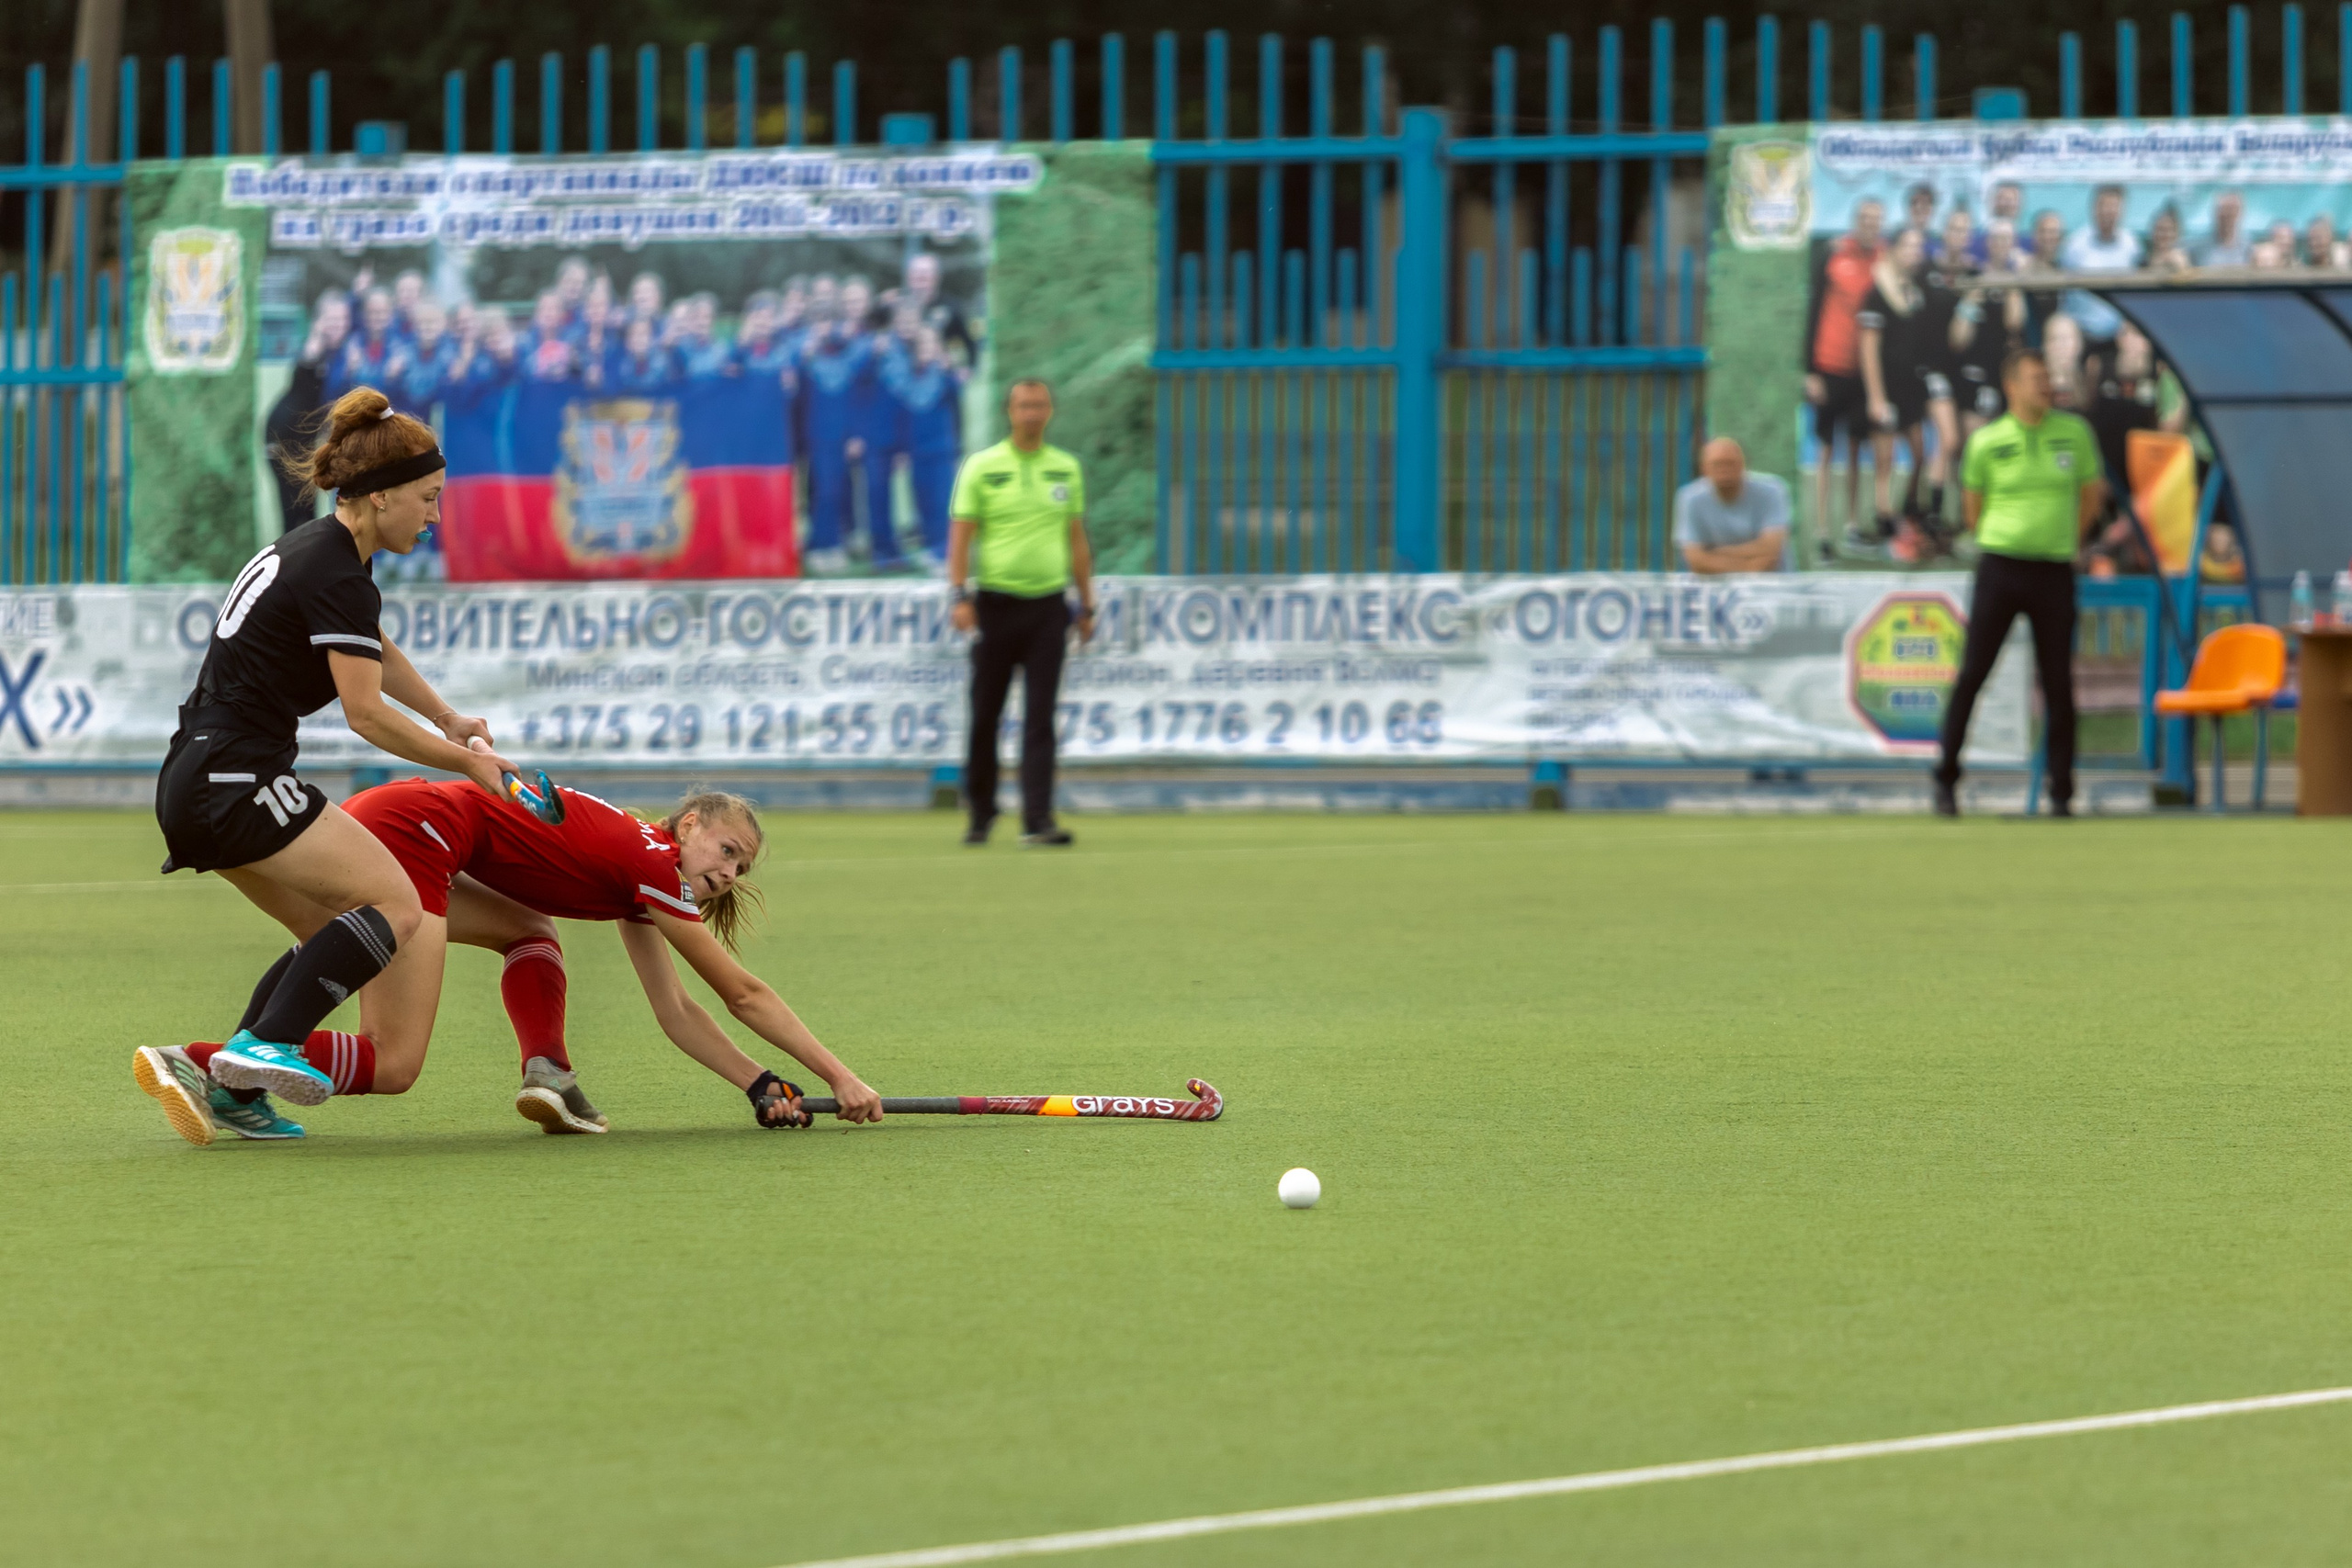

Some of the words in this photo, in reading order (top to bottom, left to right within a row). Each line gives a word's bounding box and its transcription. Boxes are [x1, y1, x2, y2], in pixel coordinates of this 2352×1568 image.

[1145, 588, 1464, 644] КОМПЛЕКС
[644, 705, 702, 751] 29
[821, 701, 876, 753] 55
[891, 701, 949, 752] 05
[1136, 702, 1251, 745] 1776
[1265, 702, 1295, 745] 2
[1313, 702, 1370, 744] 10
[254, 775, 308, 827] 10
